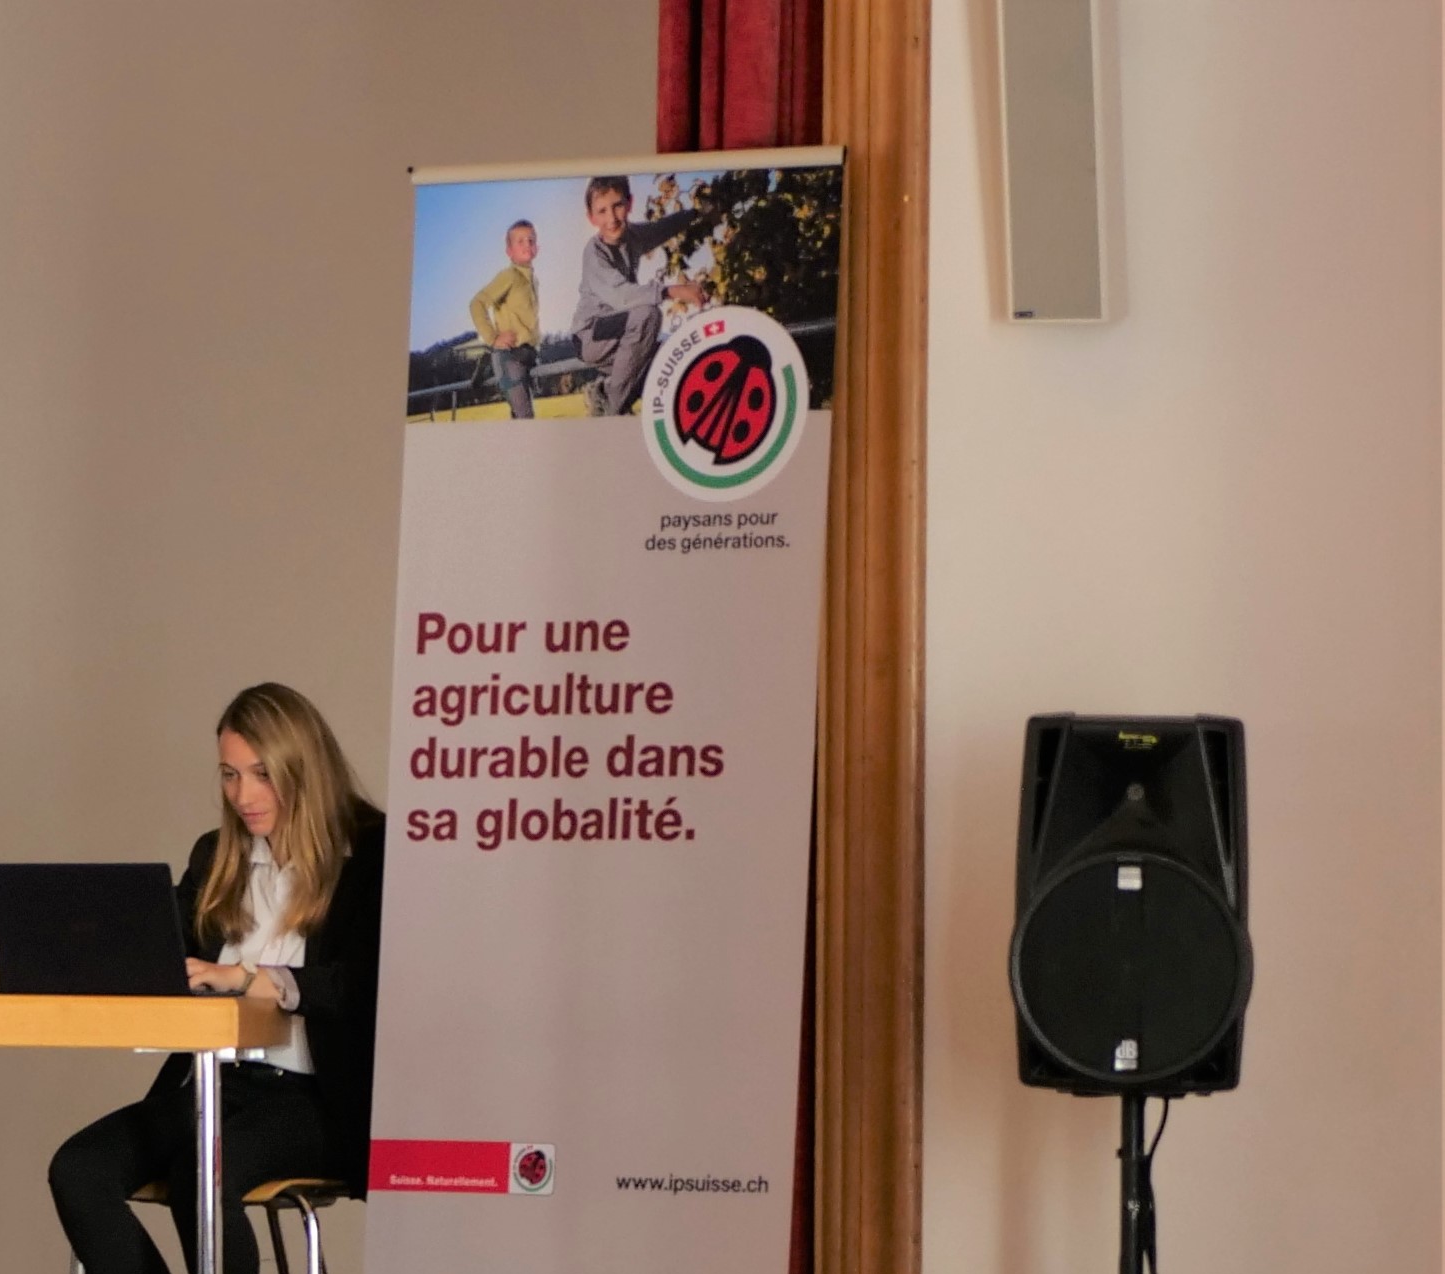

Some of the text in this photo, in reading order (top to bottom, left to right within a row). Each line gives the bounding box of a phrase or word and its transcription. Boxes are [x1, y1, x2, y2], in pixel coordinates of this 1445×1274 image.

[652, 330, 702, 414] IP-SUISSE
[644, 532, 791, 555] des générations.
[660, 512, 779, 533] paysans pour
[415, 612, 631, 656] Pour une
[412, 672, 674, 727] agriculture
[410, 734, 726, 780] durable dans
[405, 796, 697, 851] sa globalité.
[615, 1173, 770, 1196] www.ipsuisse.ch
